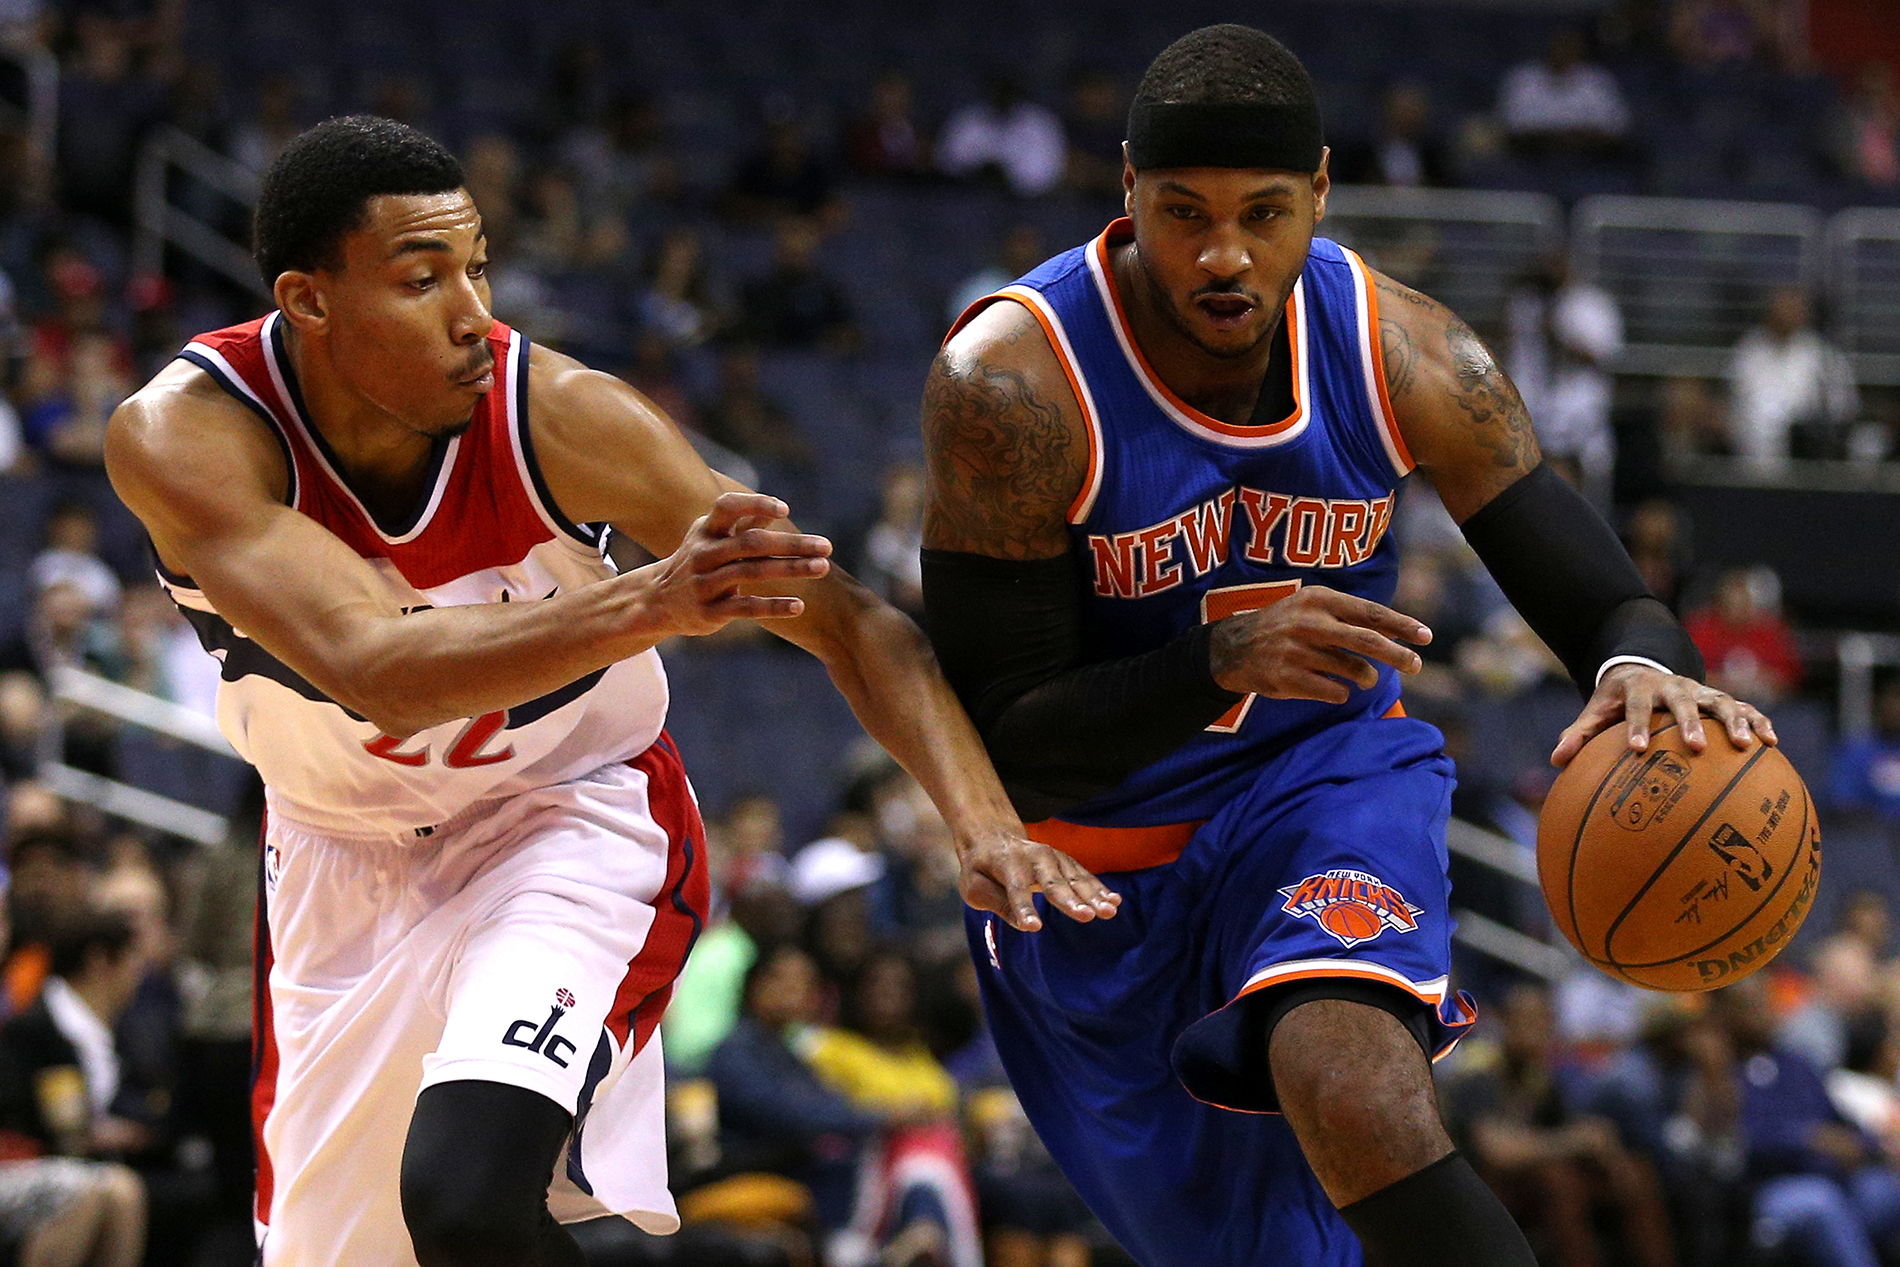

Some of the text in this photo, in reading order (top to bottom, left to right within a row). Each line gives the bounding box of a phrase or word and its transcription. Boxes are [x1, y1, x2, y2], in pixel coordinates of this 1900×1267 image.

[1088, 487, 1236, 599] NEW
[1286, 876, 1416, 927] KNICKS
[1327, 870, 1380, 886] NEW YORK
